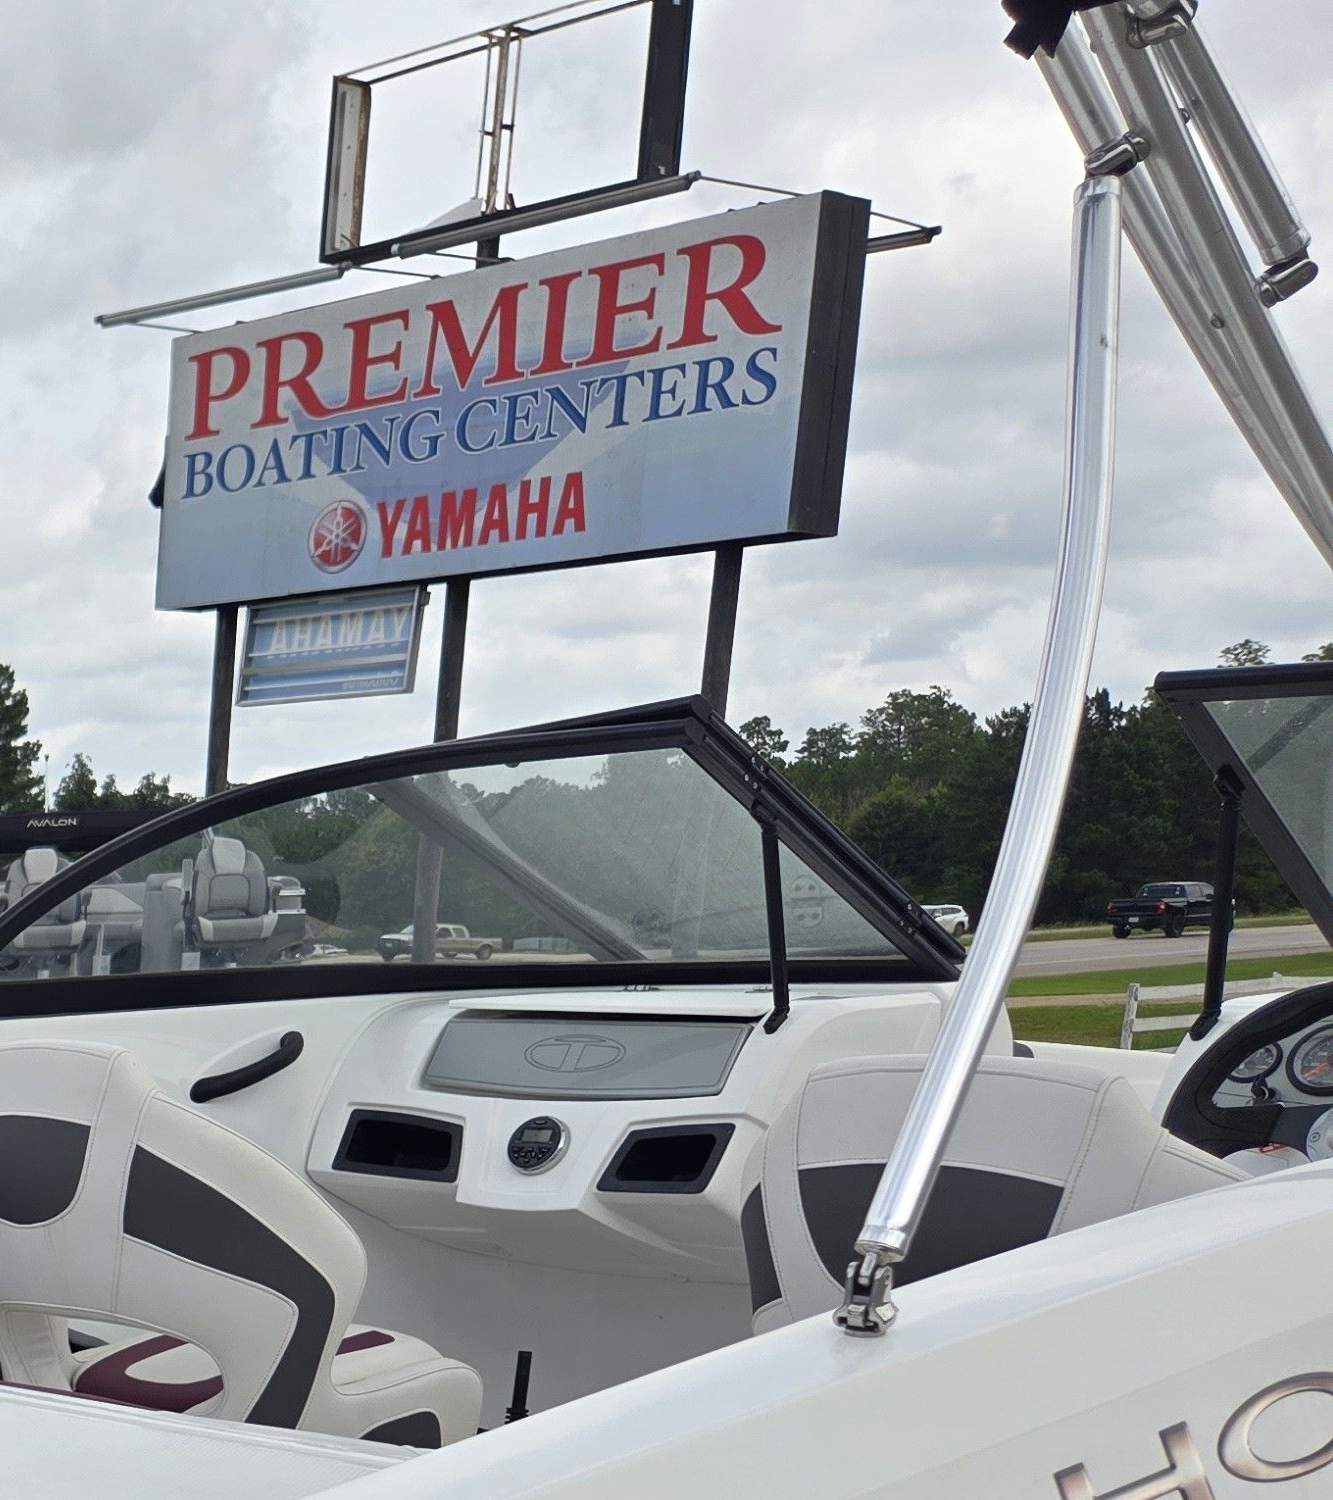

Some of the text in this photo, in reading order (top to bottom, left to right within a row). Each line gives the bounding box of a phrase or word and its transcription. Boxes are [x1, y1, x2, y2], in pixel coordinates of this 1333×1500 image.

[185, 233, 783, 441] PREMIER
[183, 346, 779, 500] BOATING CENTERS
[377, 470, 587, 559] YAMAHA
[26, 817, 77, 829] AVALON
